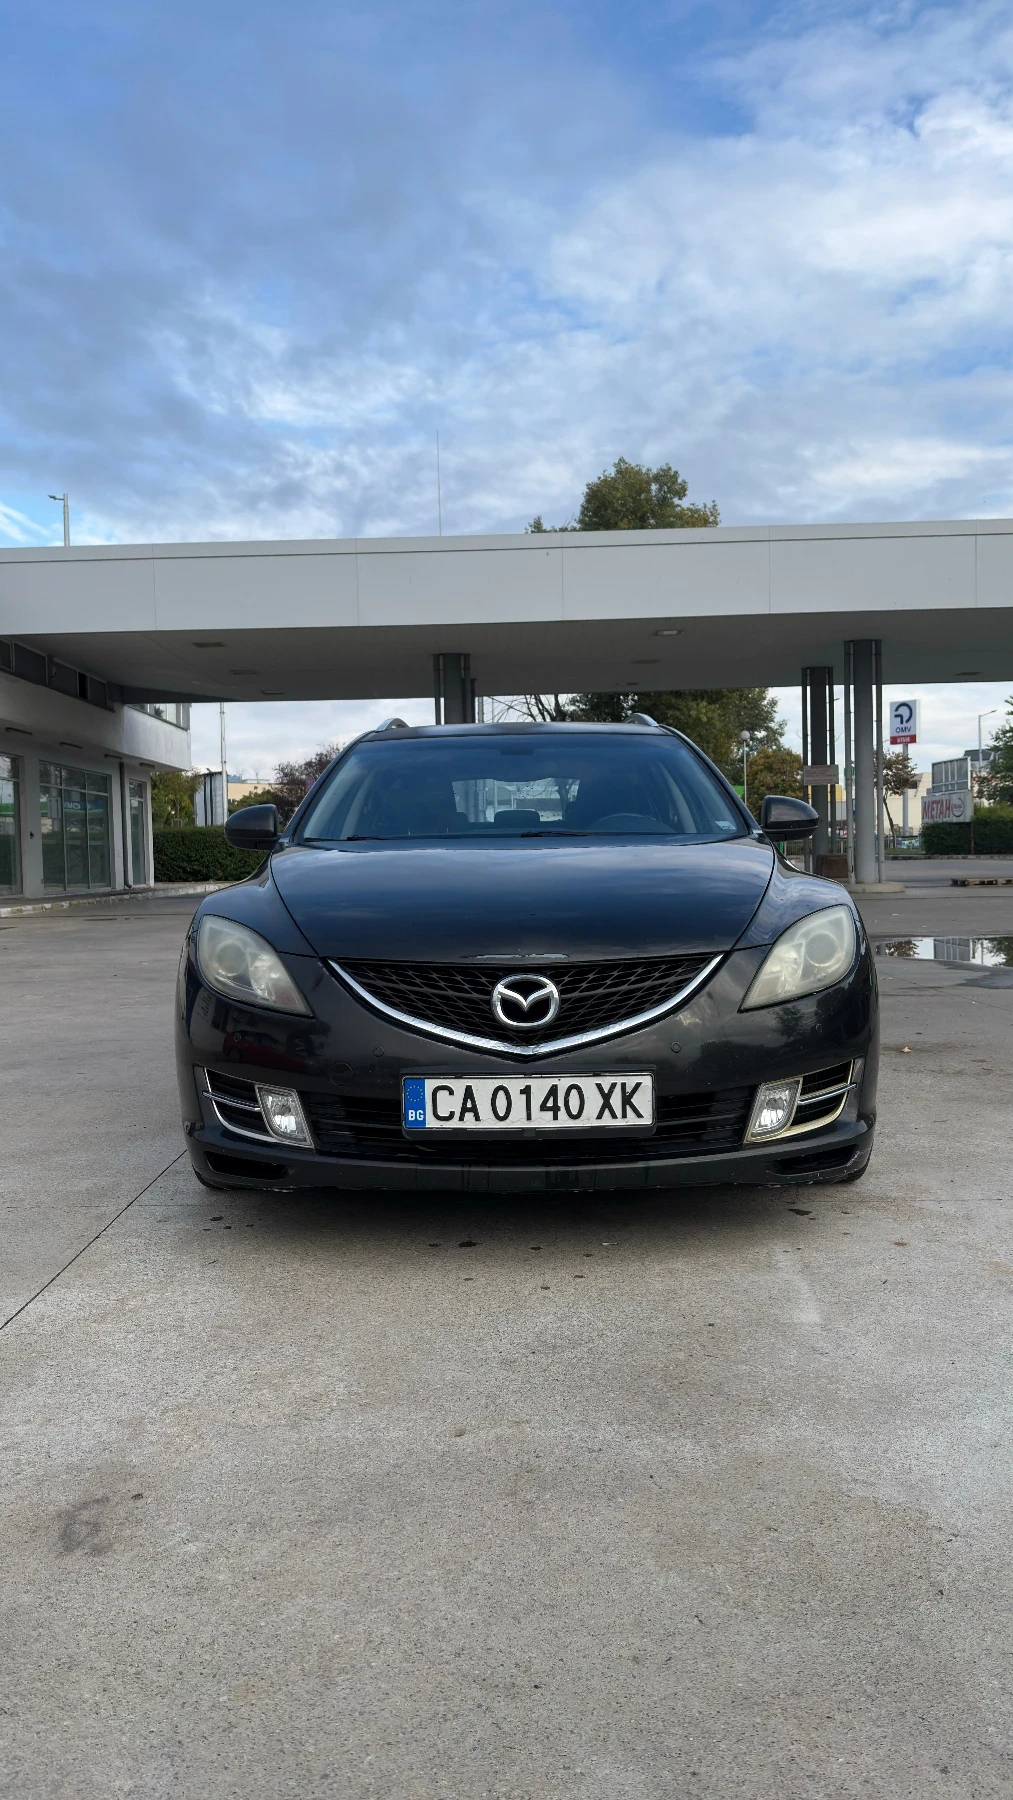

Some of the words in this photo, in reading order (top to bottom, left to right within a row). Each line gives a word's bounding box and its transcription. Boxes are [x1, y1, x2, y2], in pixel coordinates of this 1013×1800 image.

[923, 799, 951, 819] МЕТАН
[431, 1084, 481, 1122] CA
[490, 1083, 586, 1121] 0140
[595, 1081, 644, 1120] XK
[407, 1109, 424, 1121] BG
